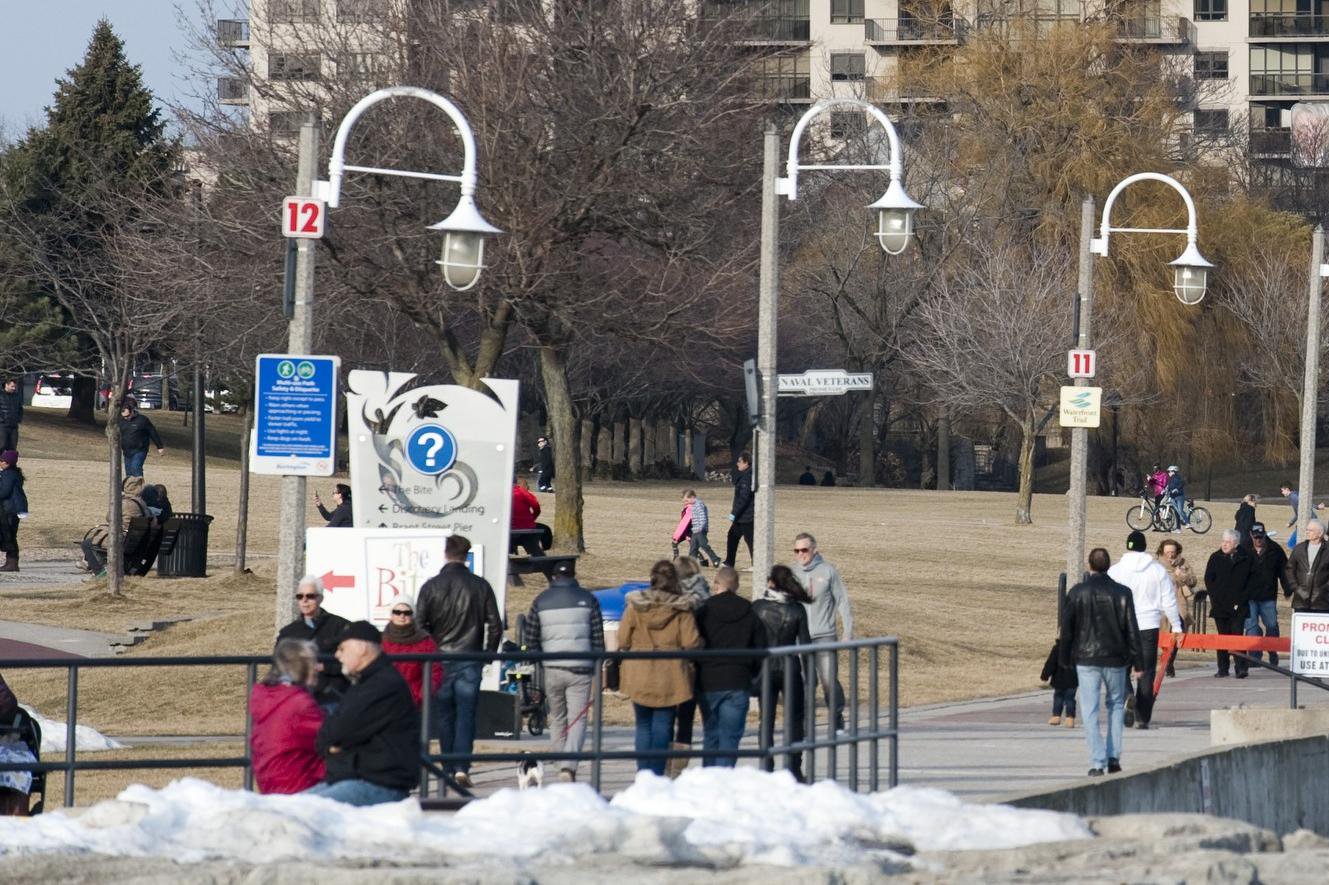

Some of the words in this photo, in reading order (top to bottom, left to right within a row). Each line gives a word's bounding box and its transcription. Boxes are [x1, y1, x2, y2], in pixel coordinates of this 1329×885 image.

[288, 202, 319, 232] 12
[1074, 354, 1090, 374] 11
[780, 378, 812, 386] NAVAL
[816, 376, 869, 386] VETERANS
[414, 485, 432, 494] Bite
[444, 504, 484, 515] Landing
[454, 523, 472, 532] Pier
[393, 541, 429, 571] The
[376, 567, 420, 608] Bit
[1297, 649, 1308, 657] DUE
[1300, 661, 1316, 670] USE
[1320, 662, 1329, 670] AT
